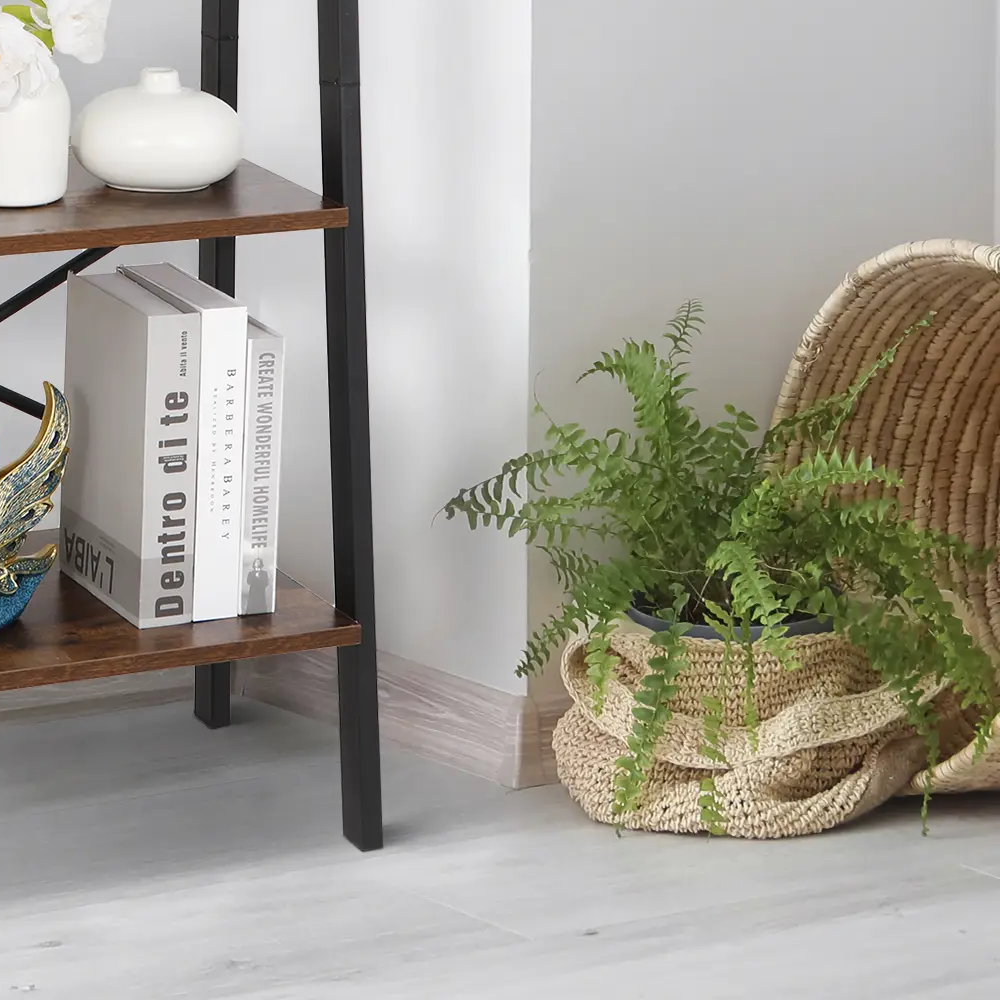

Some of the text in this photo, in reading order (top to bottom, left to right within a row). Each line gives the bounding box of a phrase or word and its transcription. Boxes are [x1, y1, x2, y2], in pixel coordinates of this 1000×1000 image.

[160, 391, 189, 427] te
[158, 438, 188, 474] di
[251, 352, 276, 549] CREATE WONDERFUL HOMELIFE
[64, 527, 115, 594] L'AIBA
[155, 491, 187, 618] Dentro
